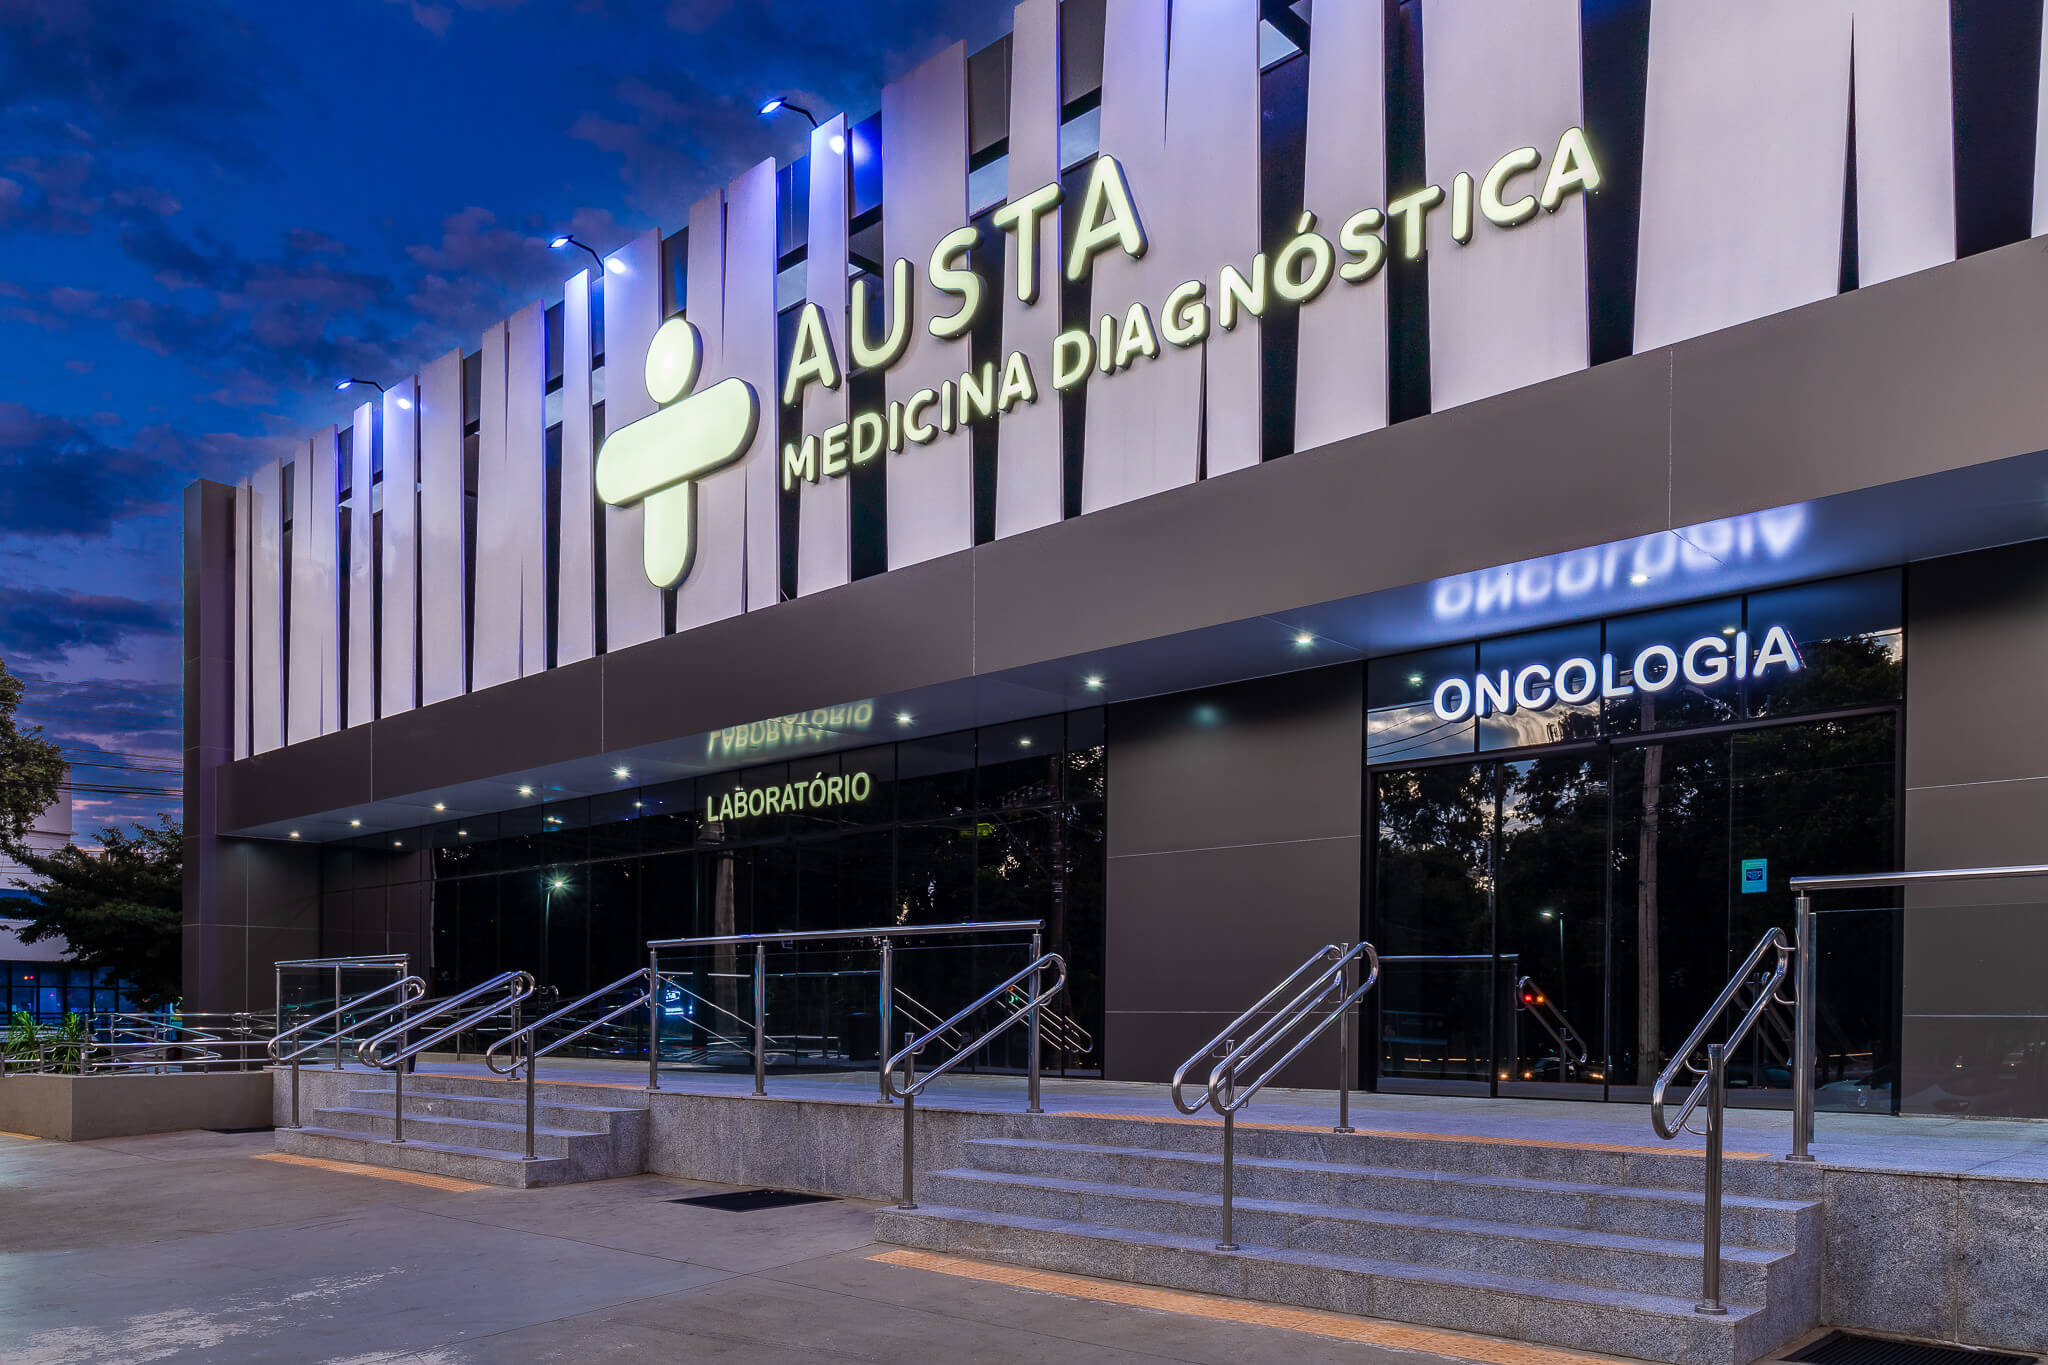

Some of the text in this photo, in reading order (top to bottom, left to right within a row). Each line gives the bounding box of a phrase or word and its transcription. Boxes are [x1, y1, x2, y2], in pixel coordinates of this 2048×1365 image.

[782, 127, 1603, 491] MEDICINA DIAGNÓSTICA
[783, 155, 1147, 406] AUSTA
[1433, 626, 1802, 723] ONCOLOGIA
[707, 772, 871, 823] LABORATÓRIO
